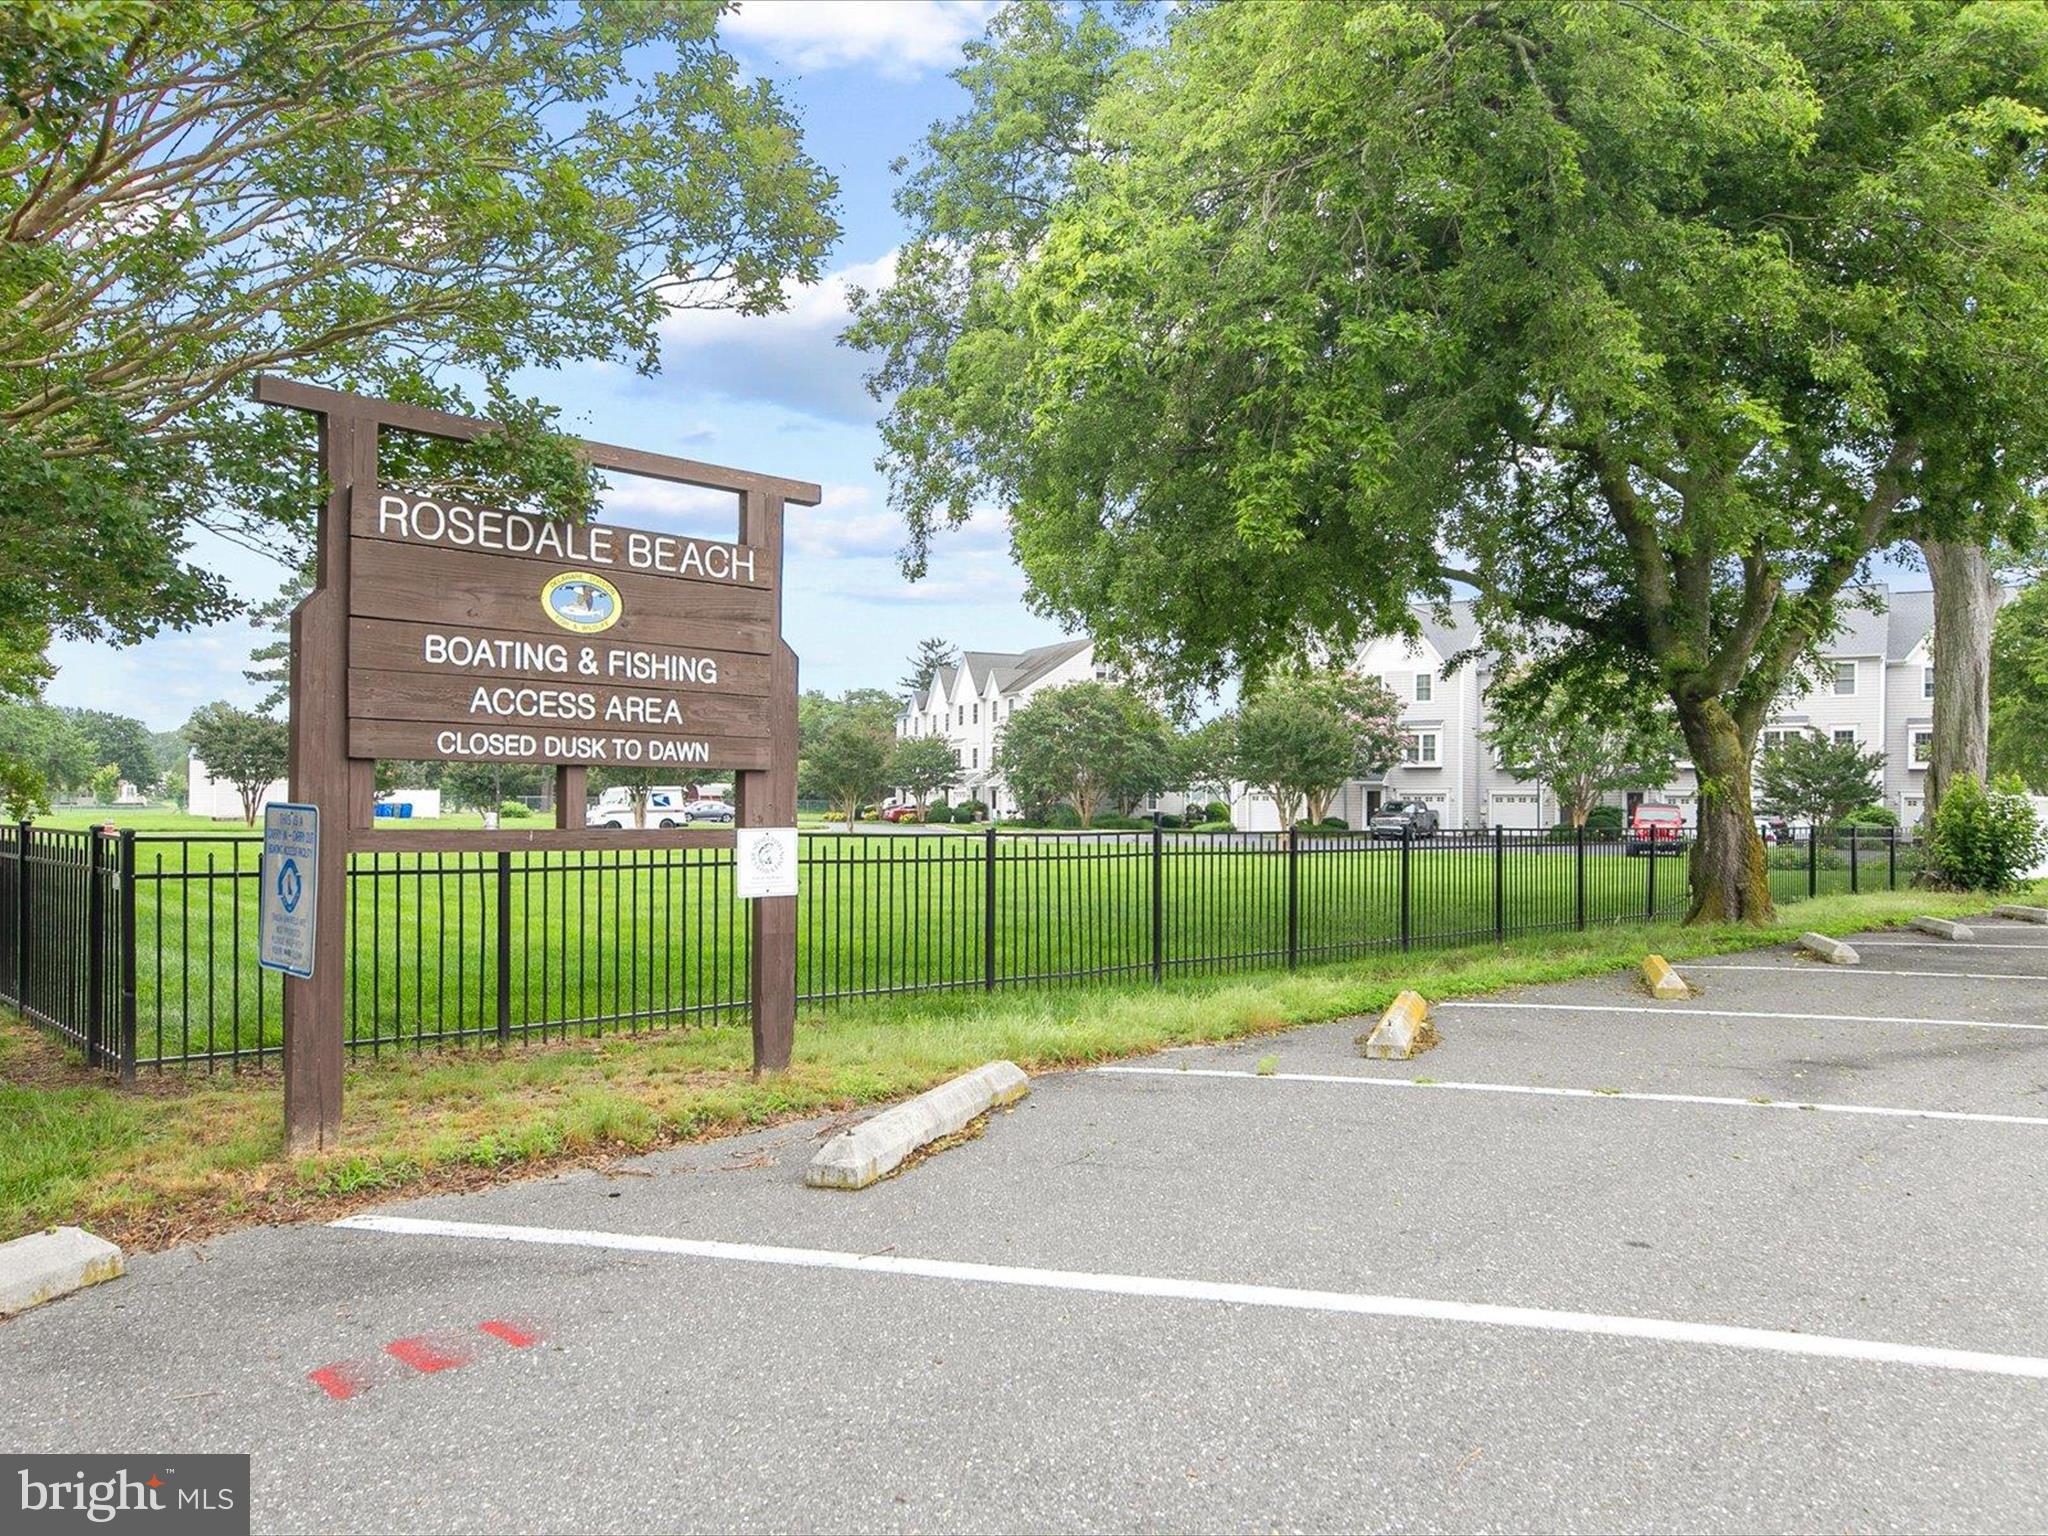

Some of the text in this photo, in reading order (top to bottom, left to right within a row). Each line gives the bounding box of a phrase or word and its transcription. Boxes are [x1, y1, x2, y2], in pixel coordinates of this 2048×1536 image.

[378, 495, 756, 582] ROSEDALE BEACH
[424, 634, 717, 684] BOATING & FISHING
[469, 686, 683, 725] ACCESS AREA
[436, 730, 709, 763] CLOSED DUSK TO DAWN
